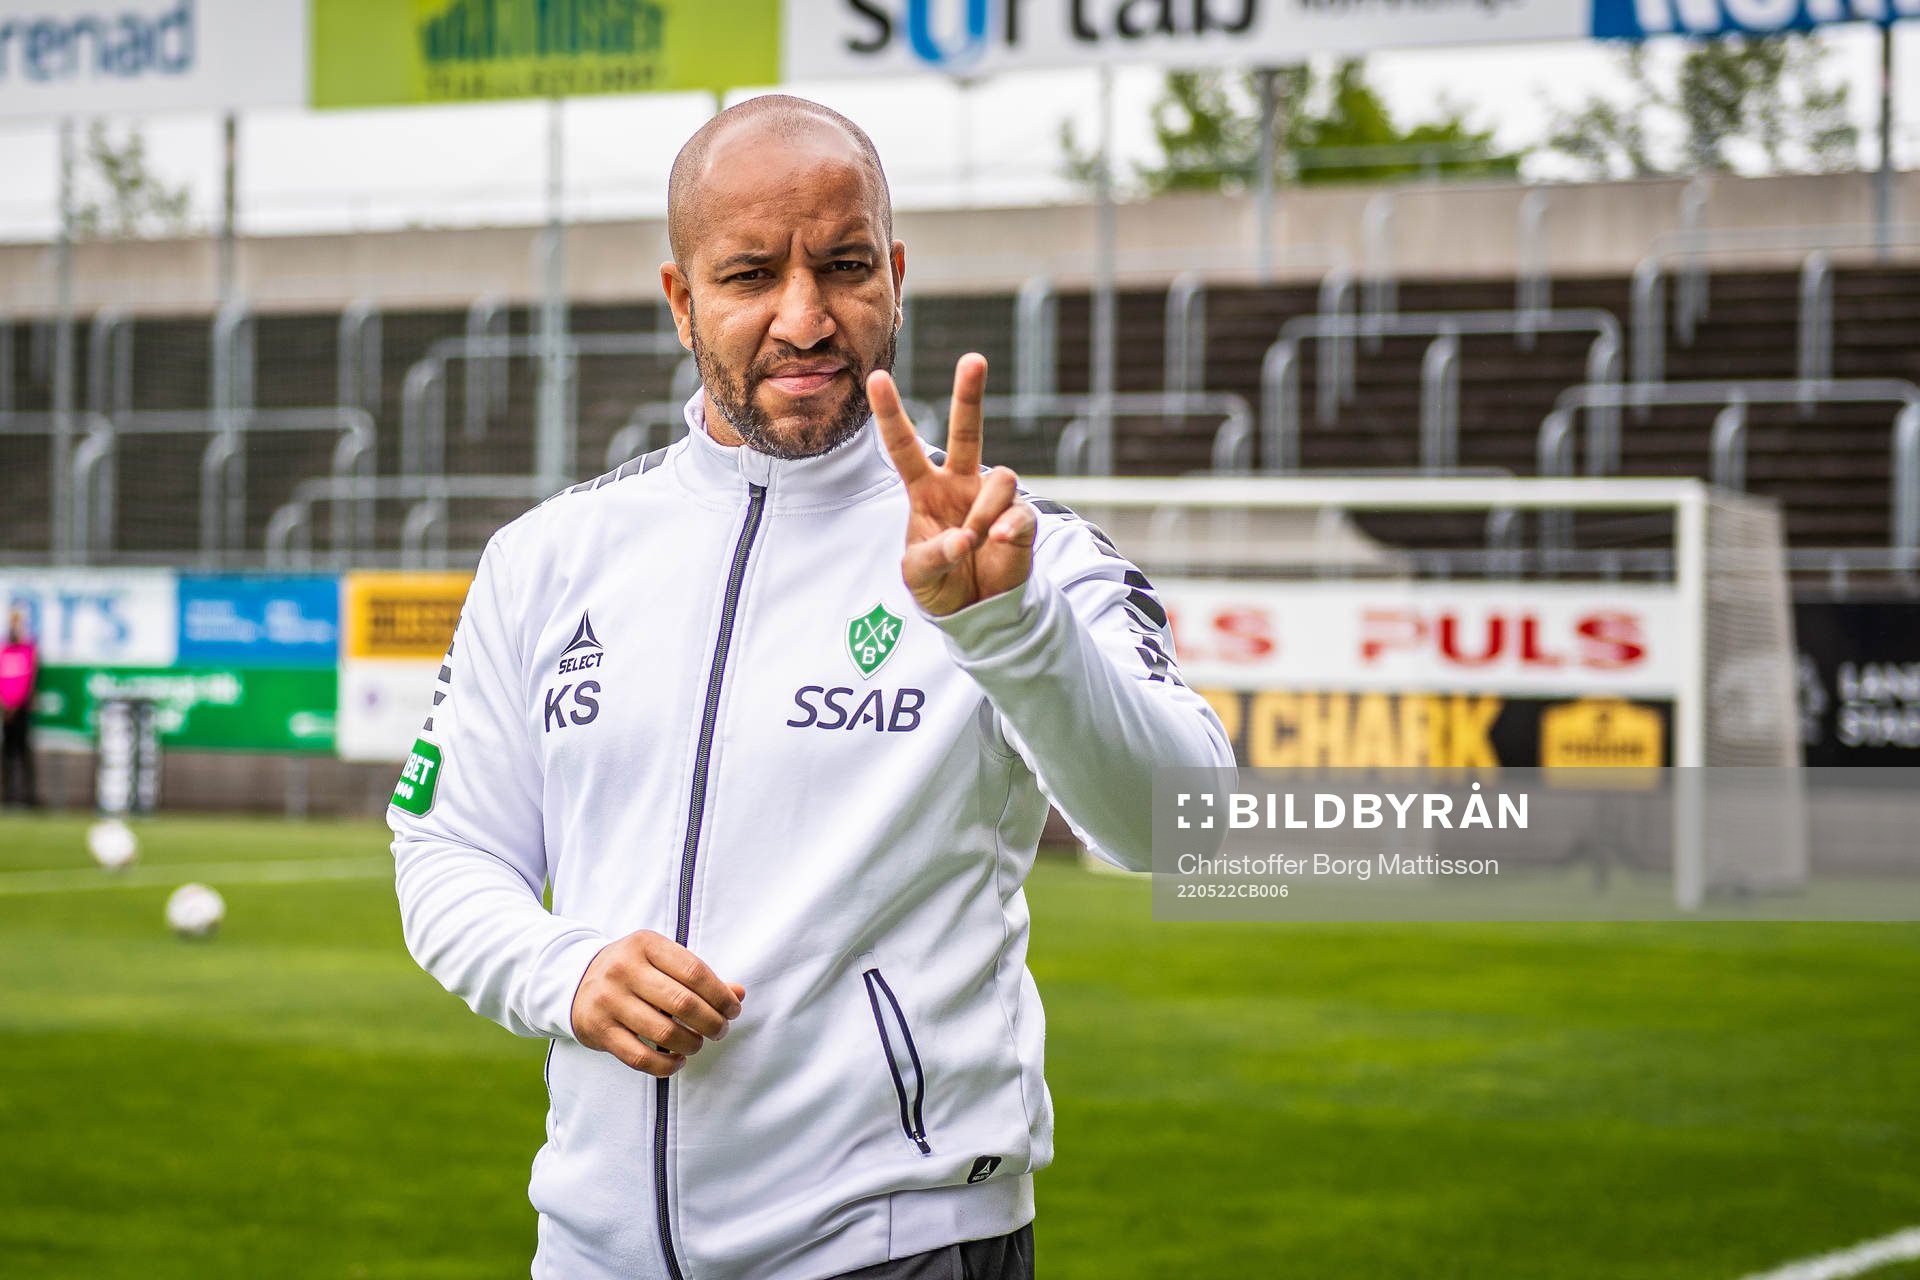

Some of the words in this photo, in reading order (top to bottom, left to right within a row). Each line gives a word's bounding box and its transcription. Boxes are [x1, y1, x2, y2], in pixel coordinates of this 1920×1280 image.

[558, 652, 604, 675] SELECT
[1360, 606, 1645, 670] PULS
[544, 679, 602, 734] KS
[786, 685, 926, 732] SSAB
[1252, 689, 1503, 784] CHARK
